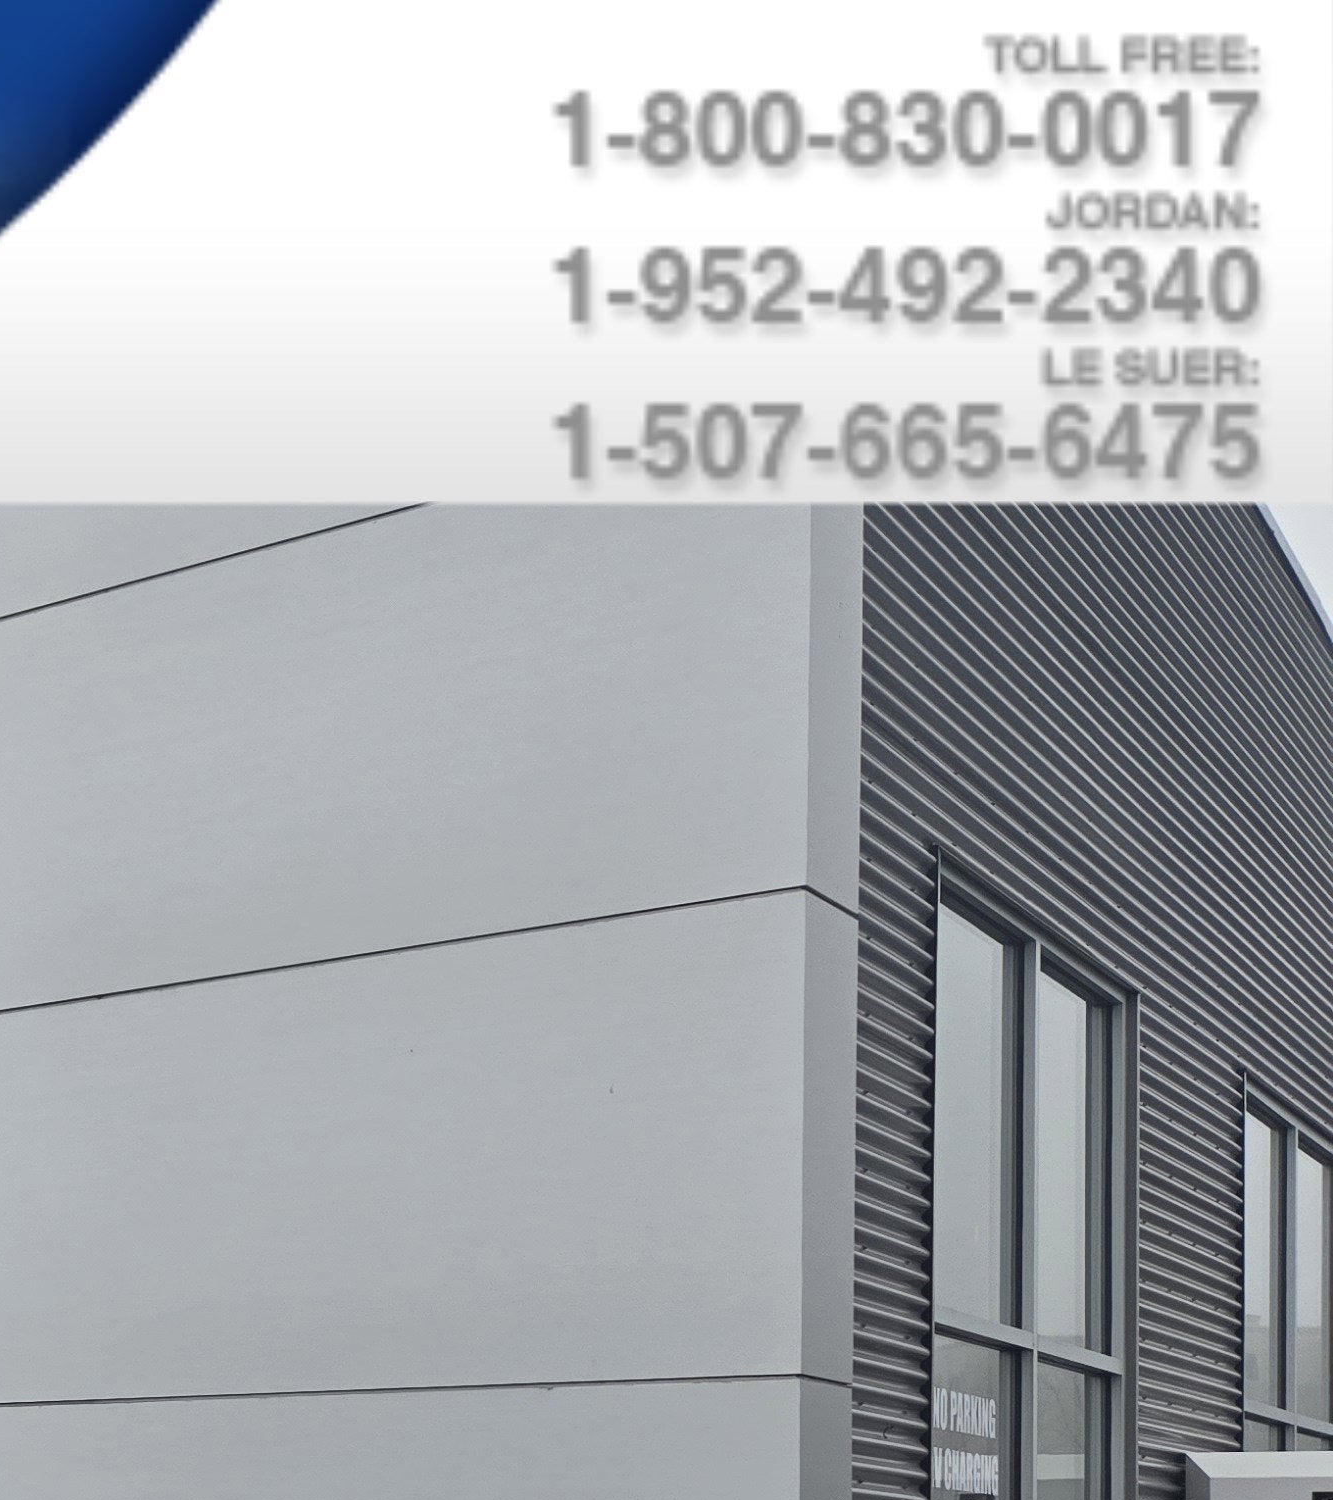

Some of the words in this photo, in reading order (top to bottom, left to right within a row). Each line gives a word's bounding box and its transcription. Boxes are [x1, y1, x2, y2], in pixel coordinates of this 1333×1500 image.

[933, 1386, 948, 1430] NO
[950, 1390, 996, 1438] PARKING
[933, 1446, 943, 1488] V
[944, 1447, 999, 1496] CHARGING
